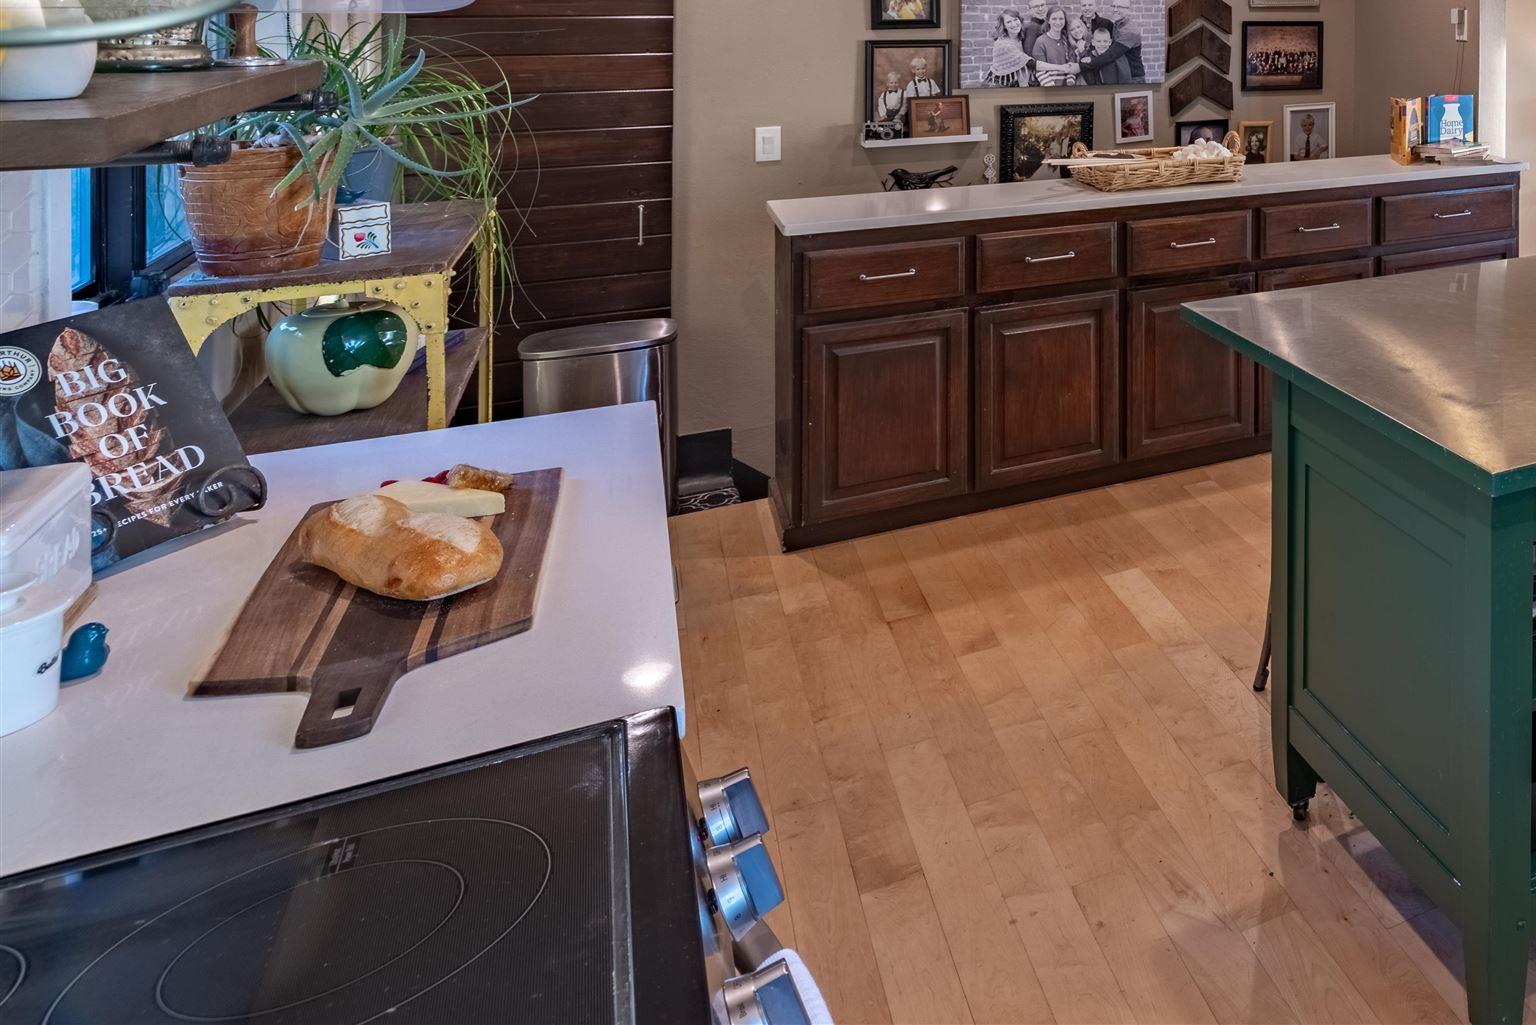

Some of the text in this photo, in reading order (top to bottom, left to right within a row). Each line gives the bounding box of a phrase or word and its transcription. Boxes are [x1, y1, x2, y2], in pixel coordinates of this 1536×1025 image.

[1440, 127, 1463, 136] Dairy
[0, 349, 32, 364] RTHUR
[54, 358, 128, 398] BIG
[44, 382, 168, 439] BOOK
[98, 425, 149, 459] OF
[116, 511, 148, 528] ECIPES
[148, 503, 168, 516] FOR
[168, 492, 195, 508] EVERY
